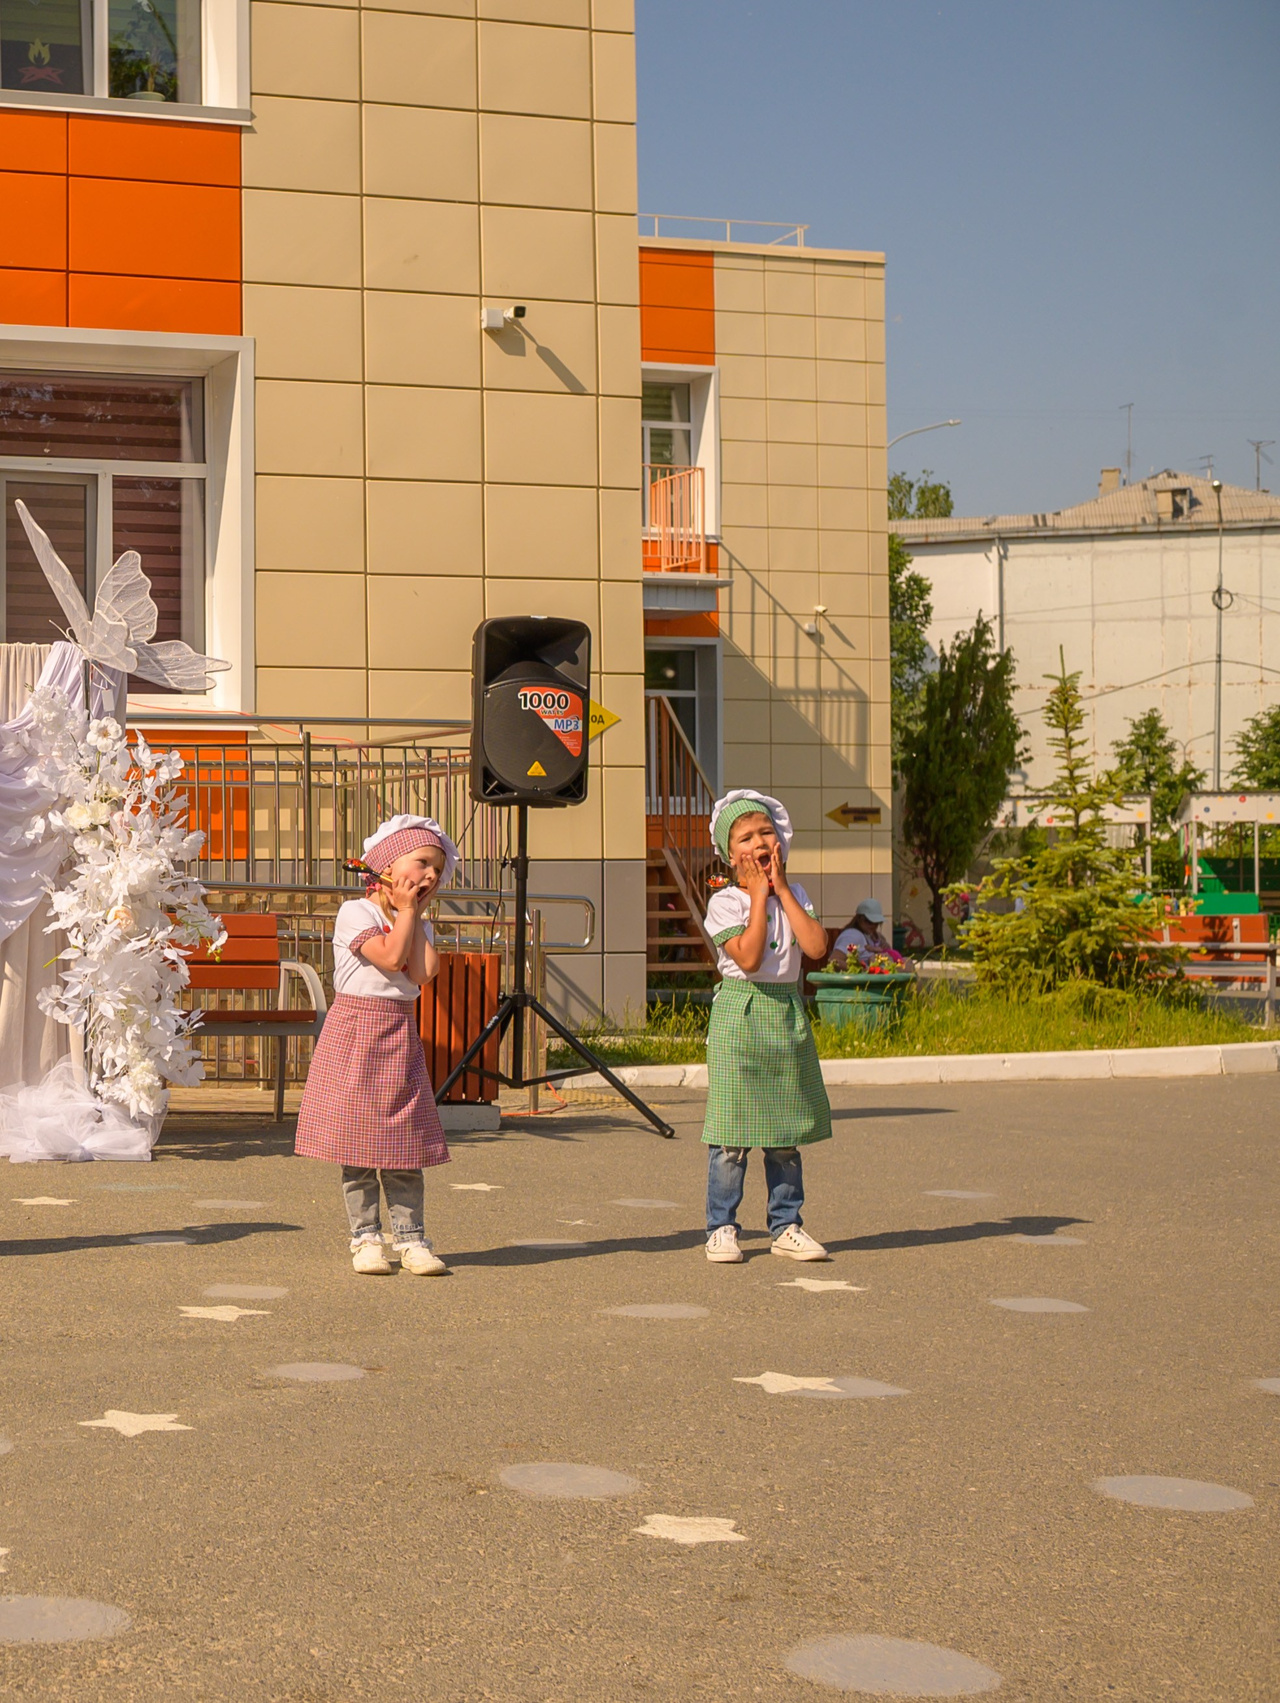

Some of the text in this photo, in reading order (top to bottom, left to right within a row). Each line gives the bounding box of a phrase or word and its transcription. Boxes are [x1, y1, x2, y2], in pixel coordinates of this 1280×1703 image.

[518, 691, 570, 710] 1000
[554, 719, 580, 730] MP3
[589, 714, 605, 725] ОД
